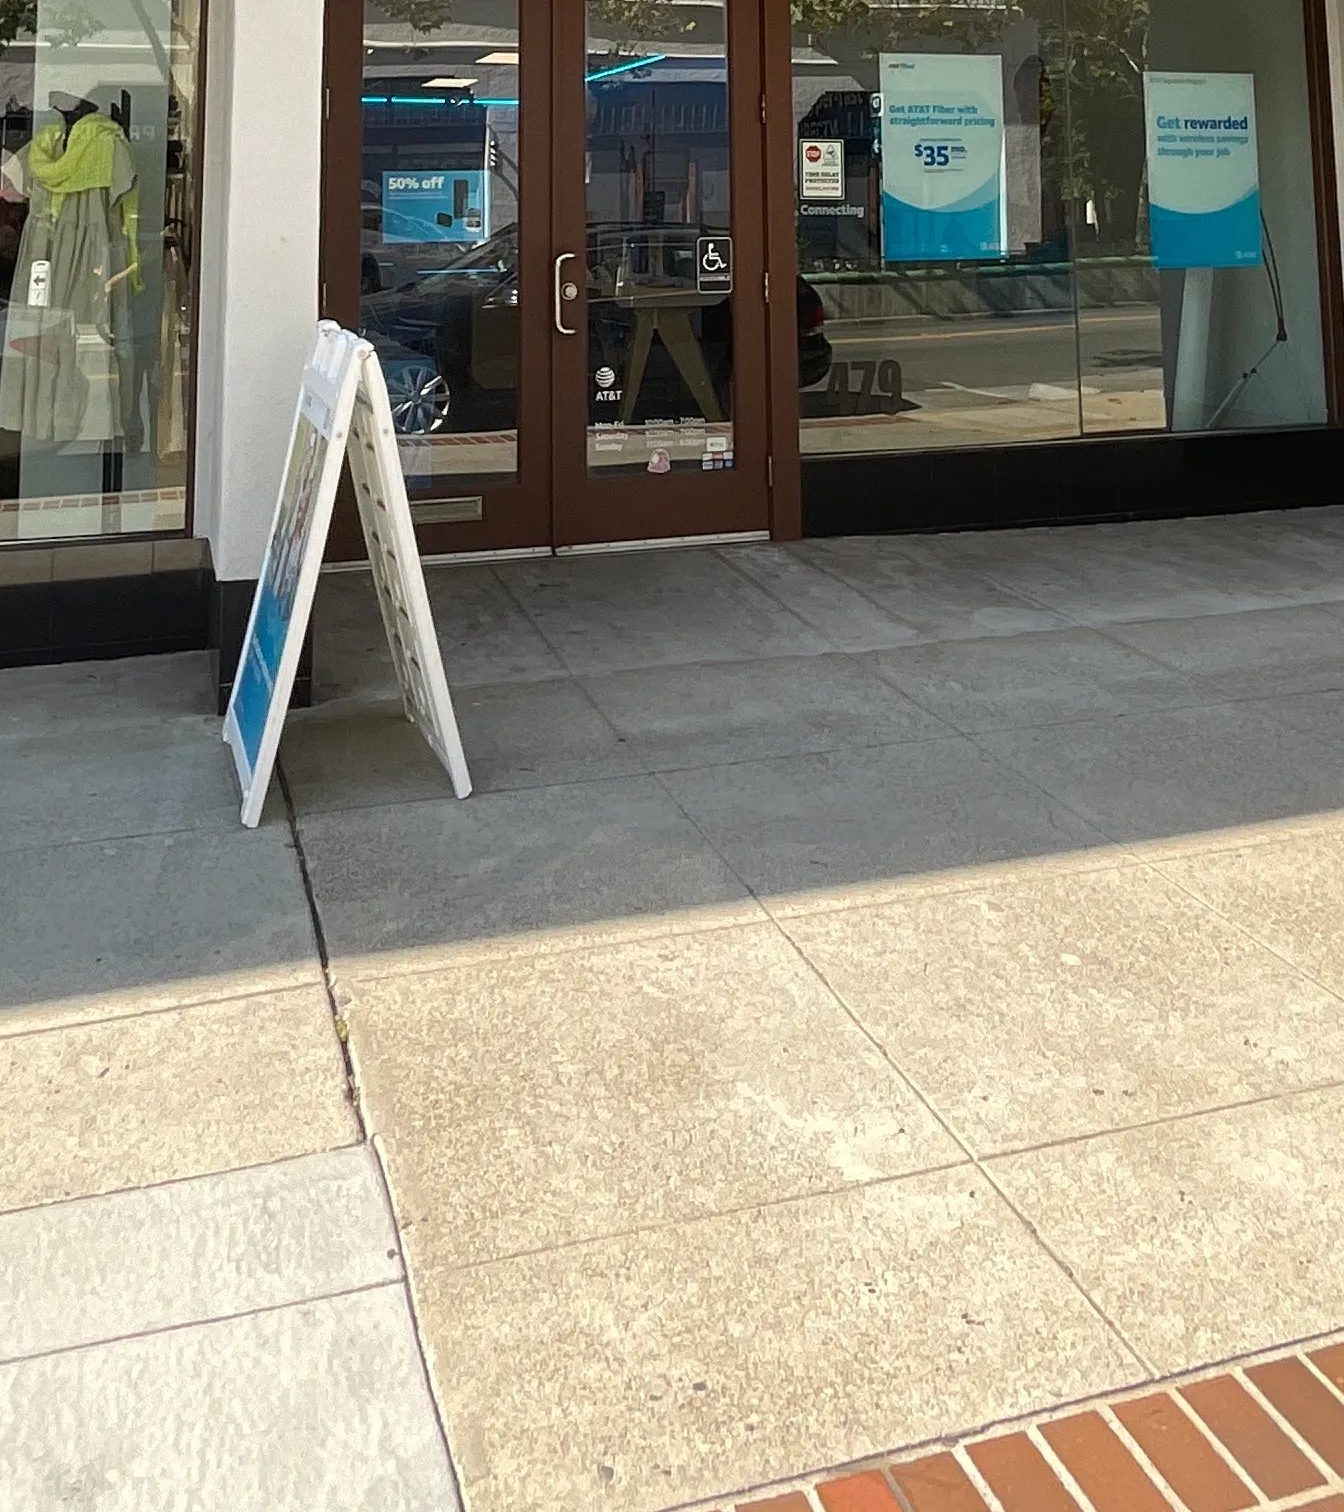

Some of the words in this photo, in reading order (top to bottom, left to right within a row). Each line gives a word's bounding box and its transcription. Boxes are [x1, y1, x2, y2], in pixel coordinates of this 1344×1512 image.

[888, 104, 906, 114] Get
[907, 104, 931, 114] AT&T
[956, 104, 978, 115] with
[889, 116, 963, 128] straightforward
[963, 117, 996, 128] pricing
[1156, 115, 1182, 130] Get
[1183, 115, 1249, 130] rewarded
[914, 143, 950, 167] $35
[388, 176, 420, 190] 50%
[421, 176, 445, 190] off
[800, 204, 865, 218] Connecting
[824, 359, 903, 414] 479
[594, 390, 623, 402] AT&T
